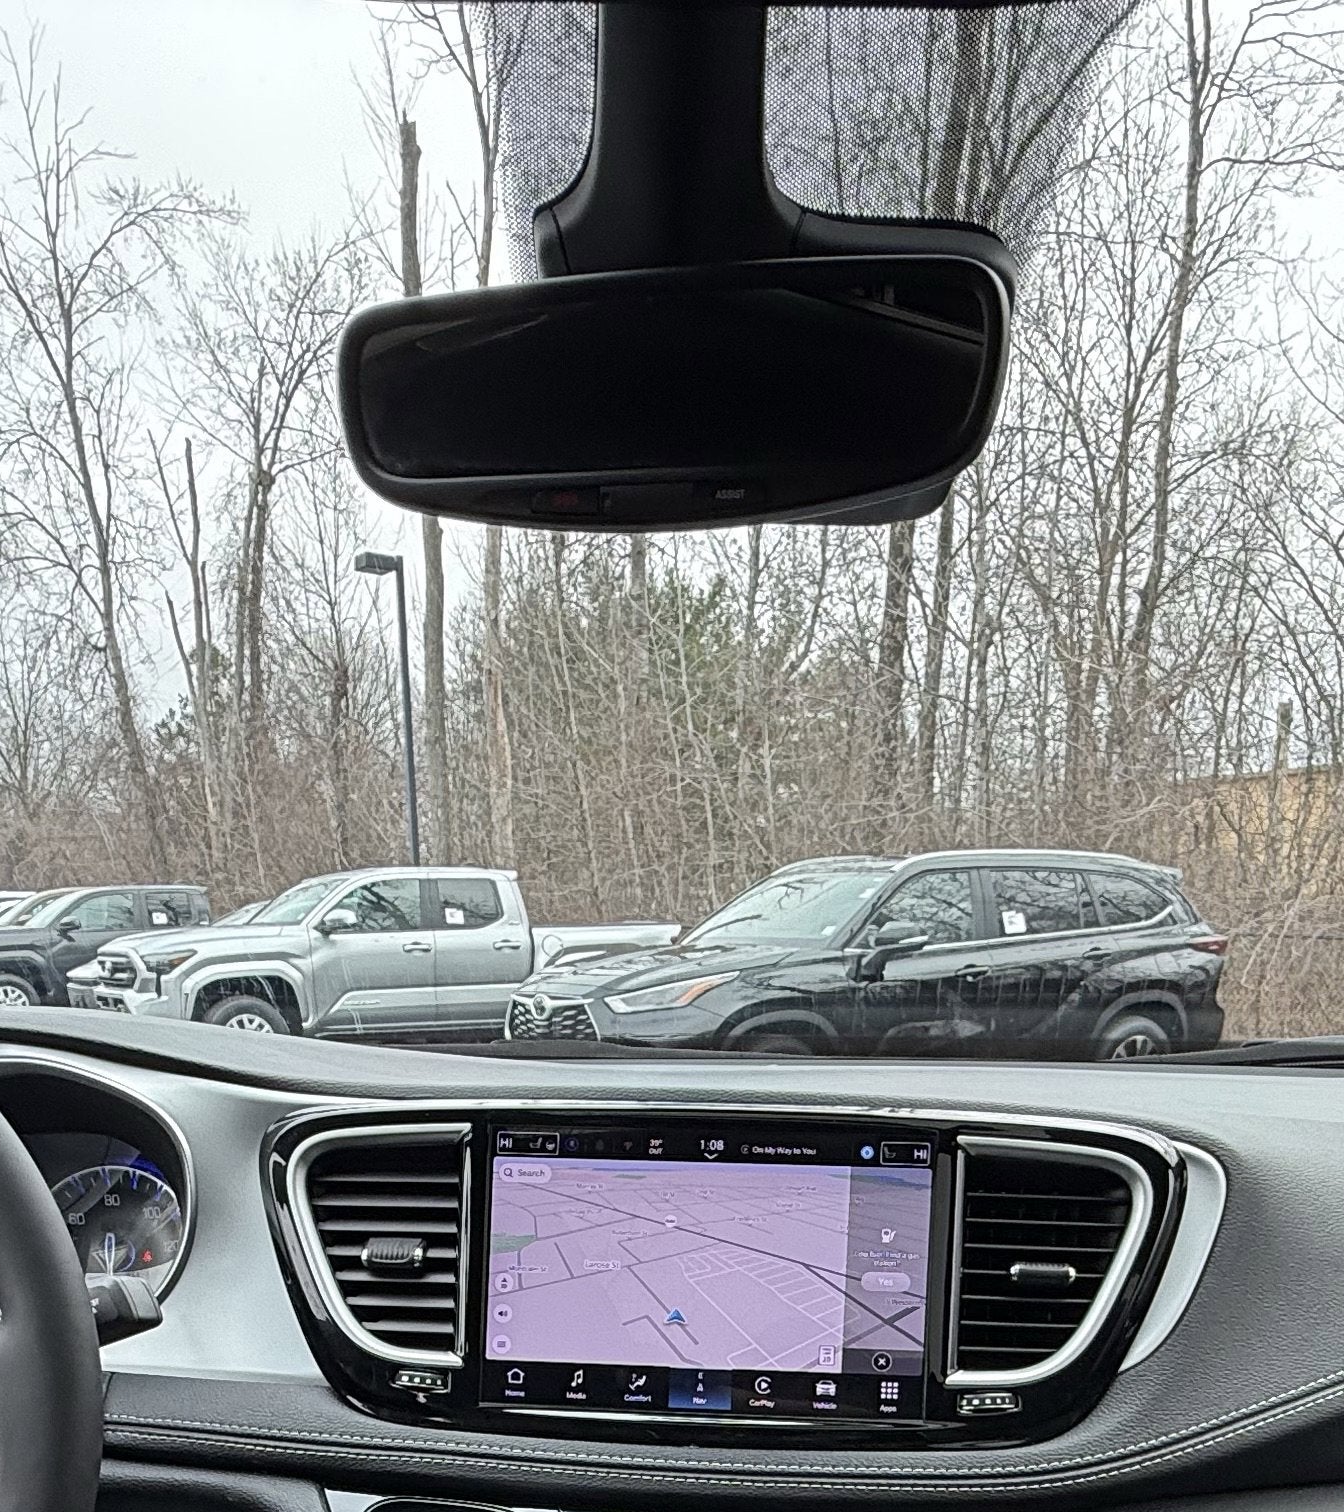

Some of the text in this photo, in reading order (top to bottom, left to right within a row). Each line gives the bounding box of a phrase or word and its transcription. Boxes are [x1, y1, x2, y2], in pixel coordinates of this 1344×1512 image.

[715, 489, 746, 499] ASSIST
[499, 1138, 513, 1149] HI
[700, 1139, 725, 1151] 1:08
[913, 1148, 928, 1160] HI
[517, 1168, 545, 1177] Search
[104, 1194, 120, 1206] 80
[142, 1207, 161, 1219] 100
[68, 1212, 85, 1225] 60
[878, 1278, 894, 1287] Yes
[505, 1389, 525, 1397] Home
[566, 1391, 587, 1399] Media
[624, 1394, 651, 1402] Comfort
[692, 1397, 707, 1405] Nav
[749, 1399, 775, 1408] CarPlay
[812, 1402, 837, 1410] Vehicle
[879, 1404, 897, 1413] Apps
